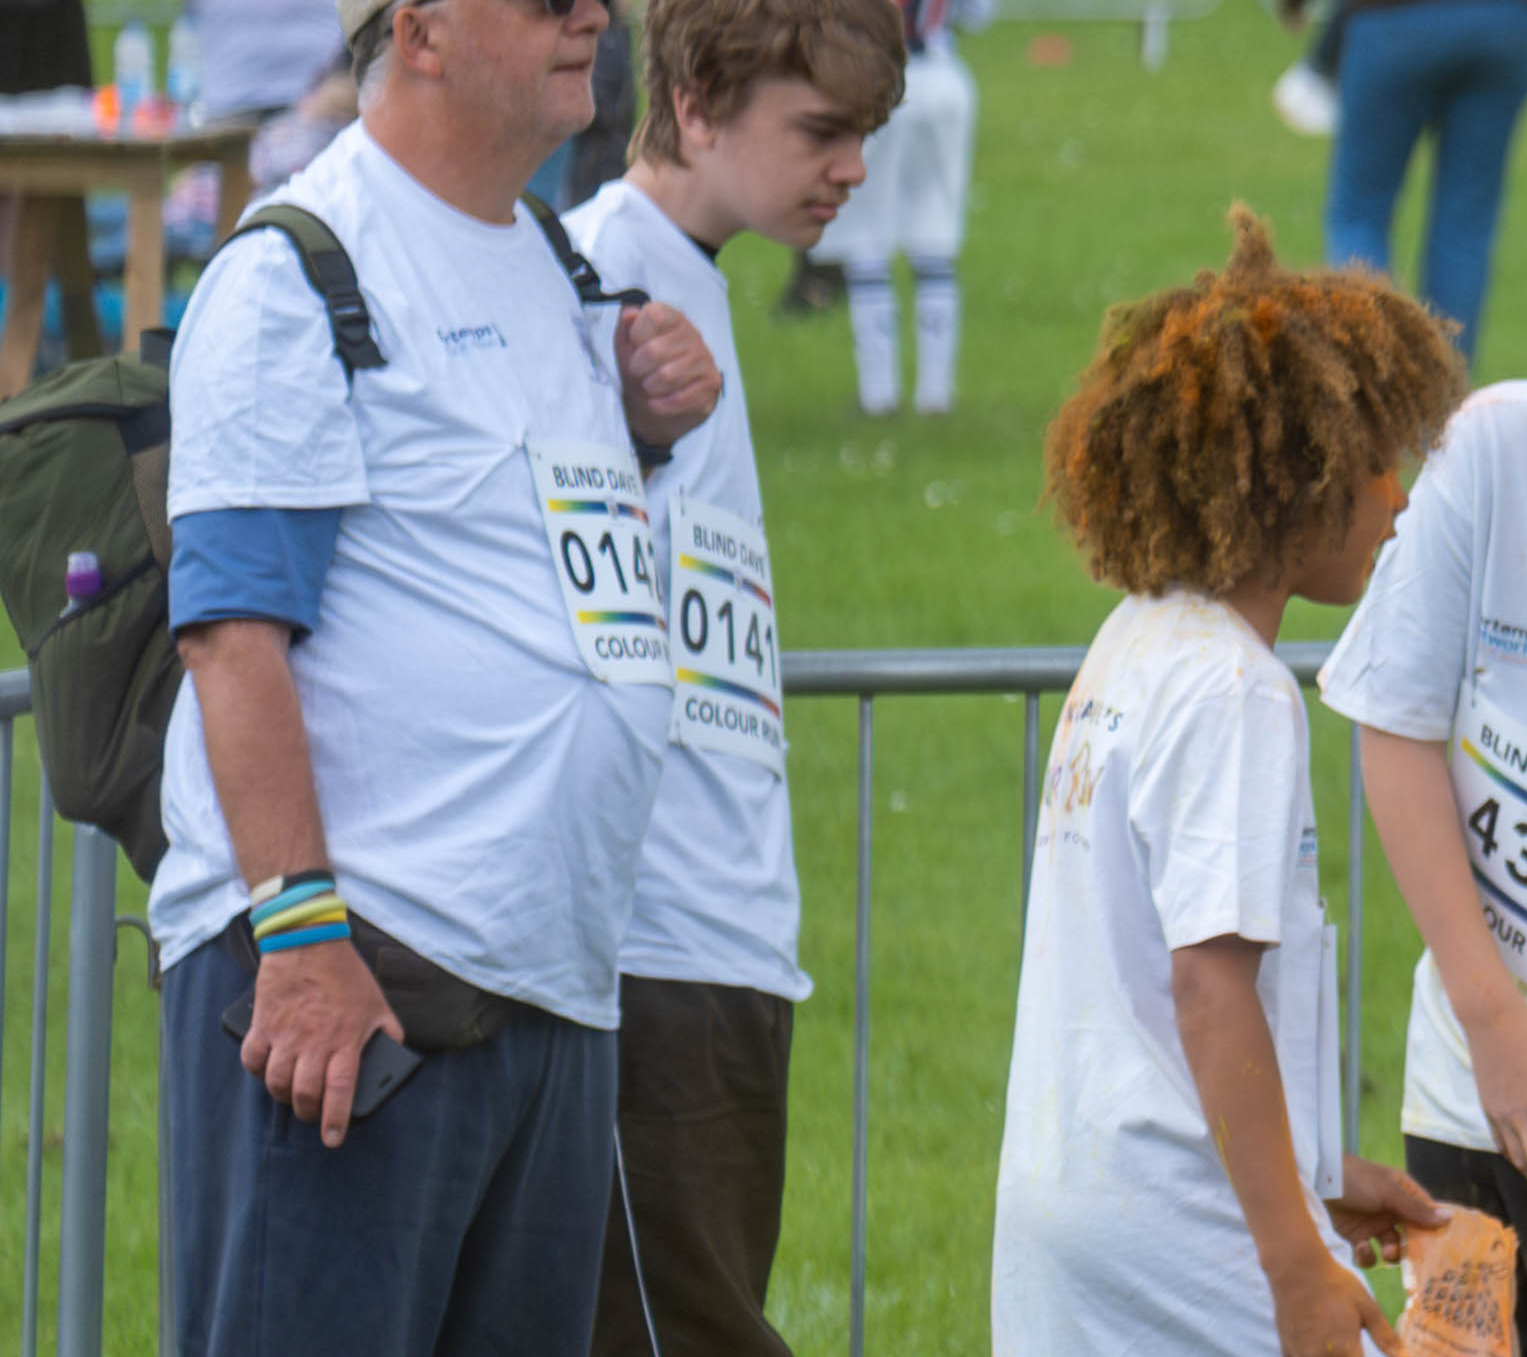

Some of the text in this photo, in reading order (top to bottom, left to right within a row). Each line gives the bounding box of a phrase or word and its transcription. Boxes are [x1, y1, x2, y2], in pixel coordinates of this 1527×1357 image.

[552, 465, 604, 490] BLIND
[692, 524, 737, 560] BLIND
[680, 587, 778, 691] 0141
[685, 697, 760, 736] COLOUR
[1483, 905, 1527, 955] OUR
